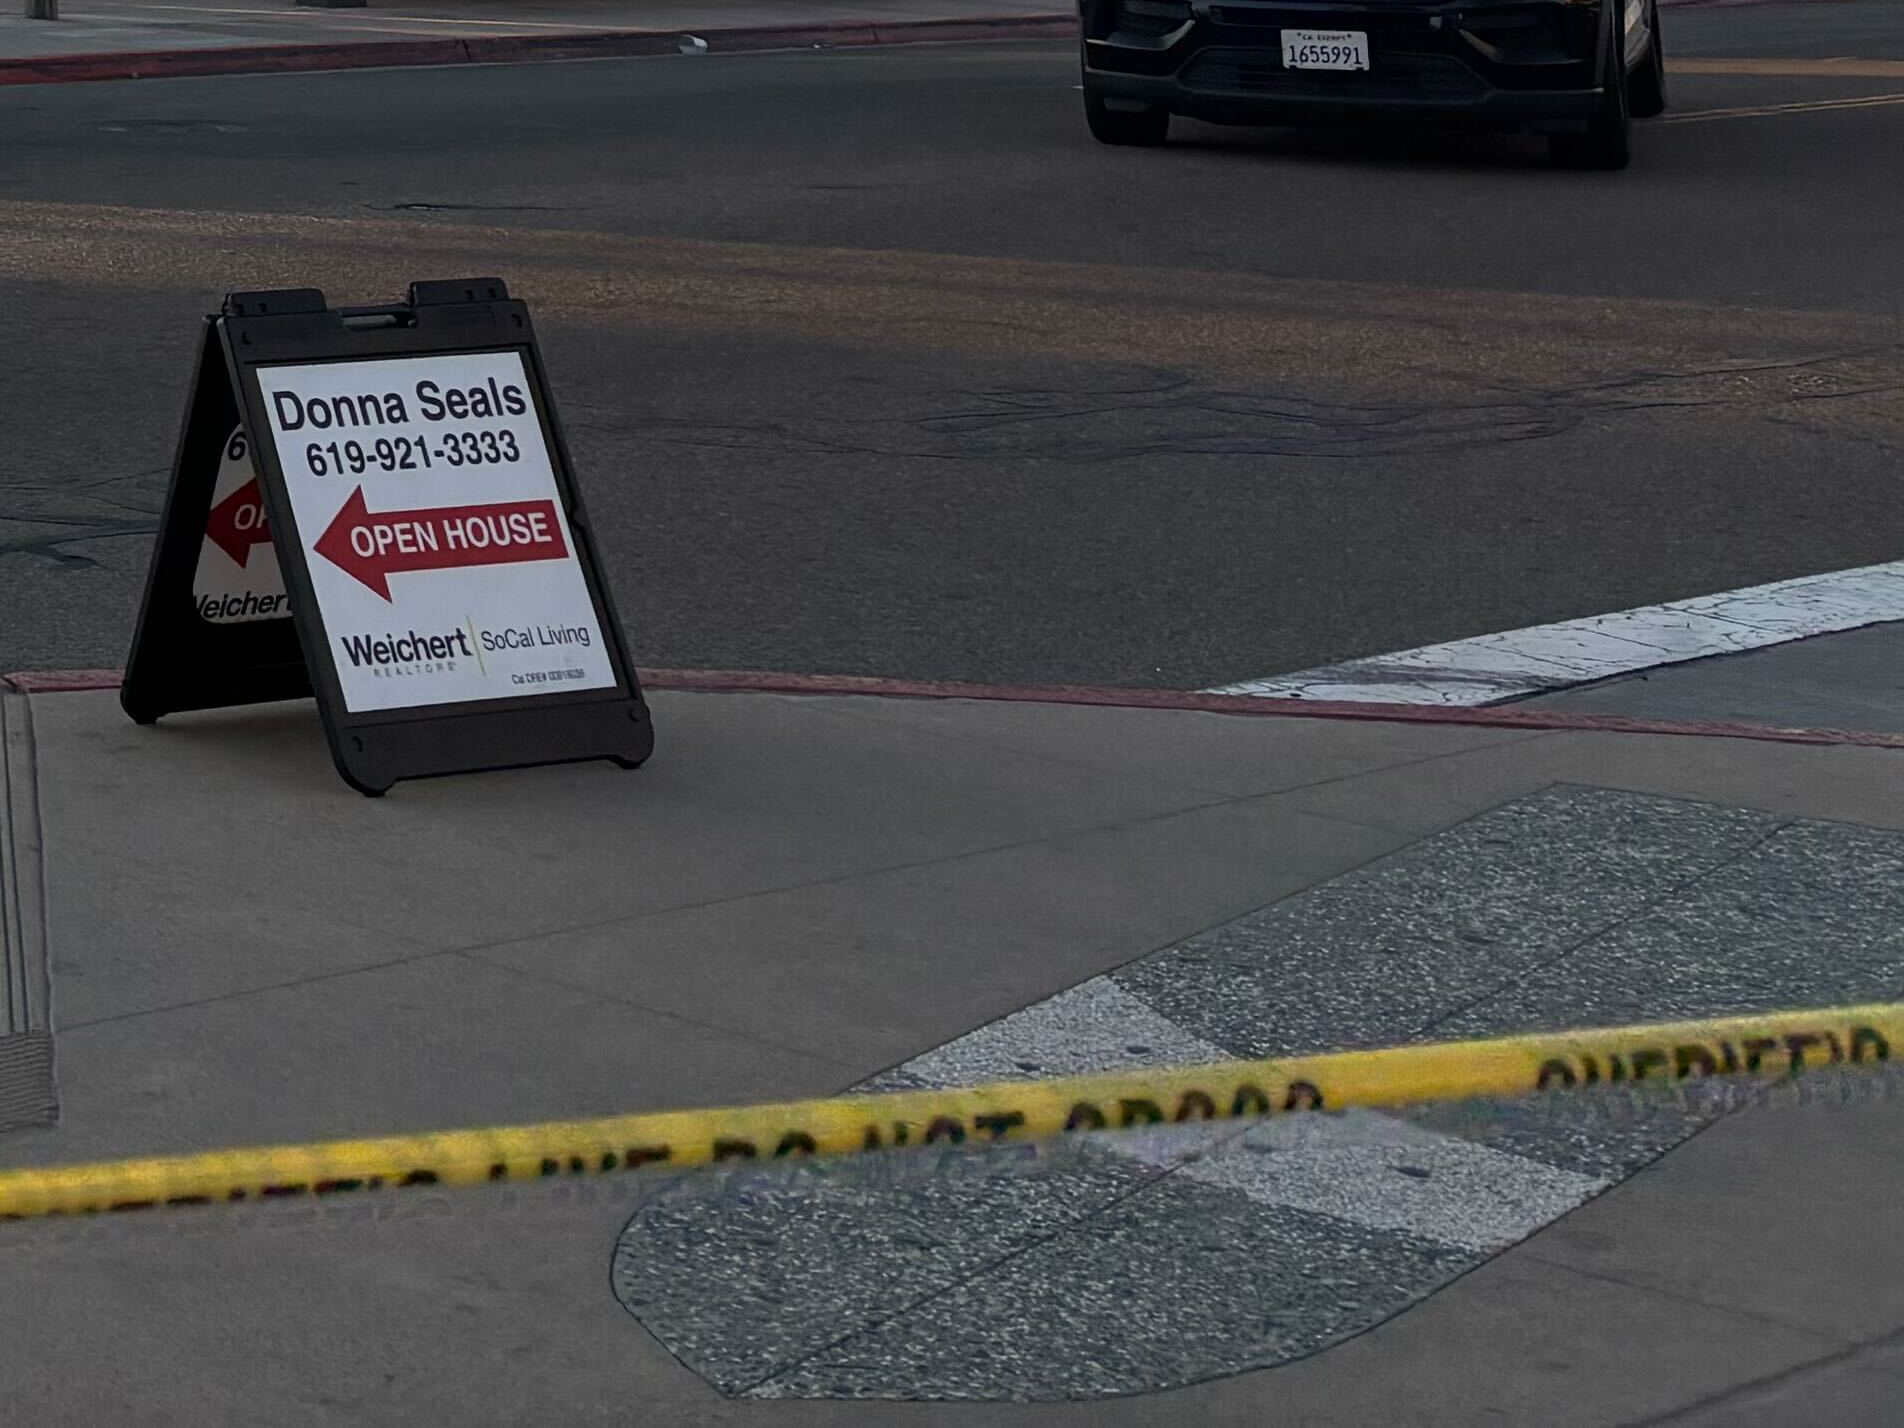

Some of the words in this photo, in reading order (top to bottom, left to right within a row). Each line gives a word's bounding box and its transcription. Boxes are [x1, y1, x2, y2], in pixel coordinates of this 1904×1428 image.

[1289, 45, 1362, 65] 1655991
[273, 390, 409, 431] Donna
[415, 377, 526, 421] Seals
[306, 429, 520, 476] 619-921-3333
[350, 521, 439, 557] OPEN
[443, 512, 552, 549] HOUSE
[341, 627, 473, 667] Weichert
[481, 628, 535, 652] SoCal
[537, 624, 590, 647] Living
